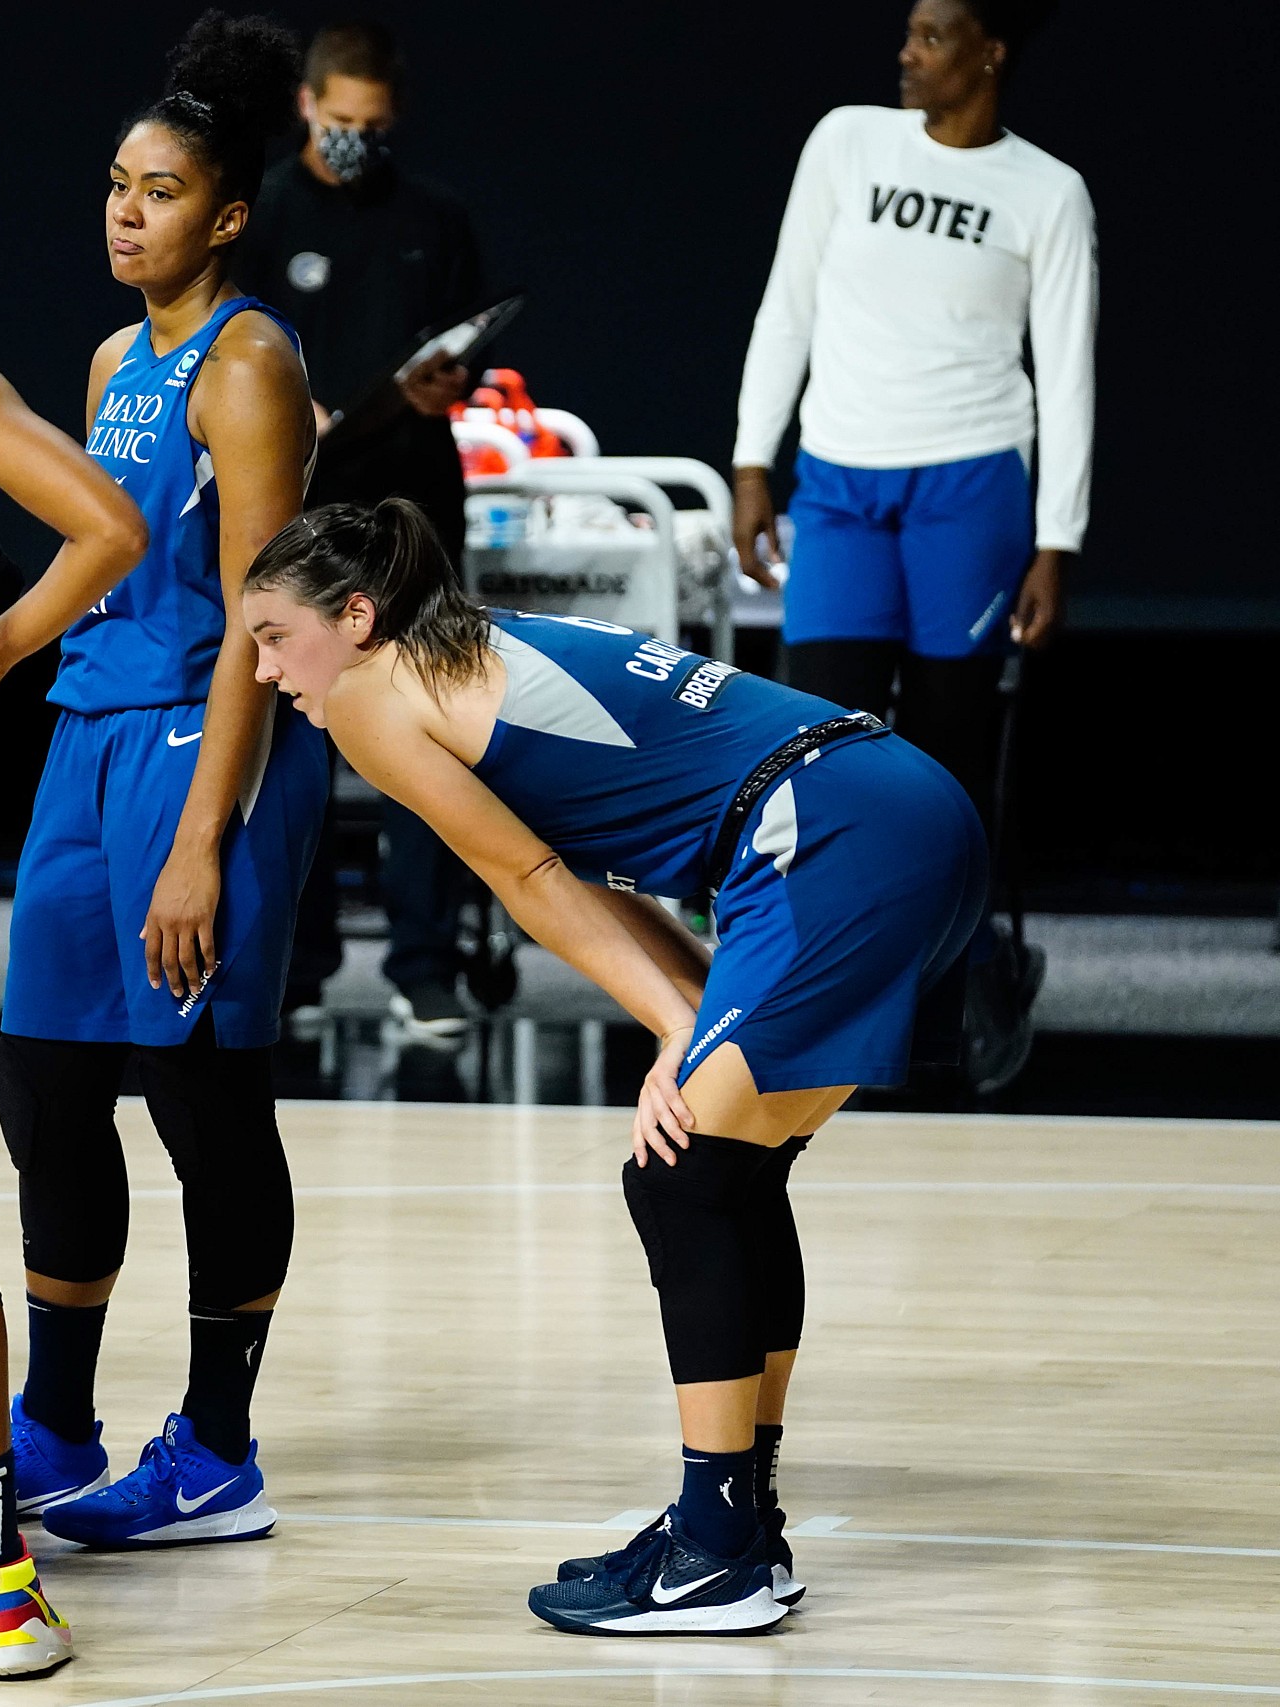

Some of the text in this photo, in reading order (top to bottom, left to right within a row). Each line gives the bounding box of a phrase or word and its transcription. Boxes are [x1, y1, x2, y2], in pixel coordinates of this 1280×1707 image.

[869, 185, 992, 244] VOTE!
[98, 392, 163, 424] MAYO
[686, 1007, 743, 1064] MINNESOTA
